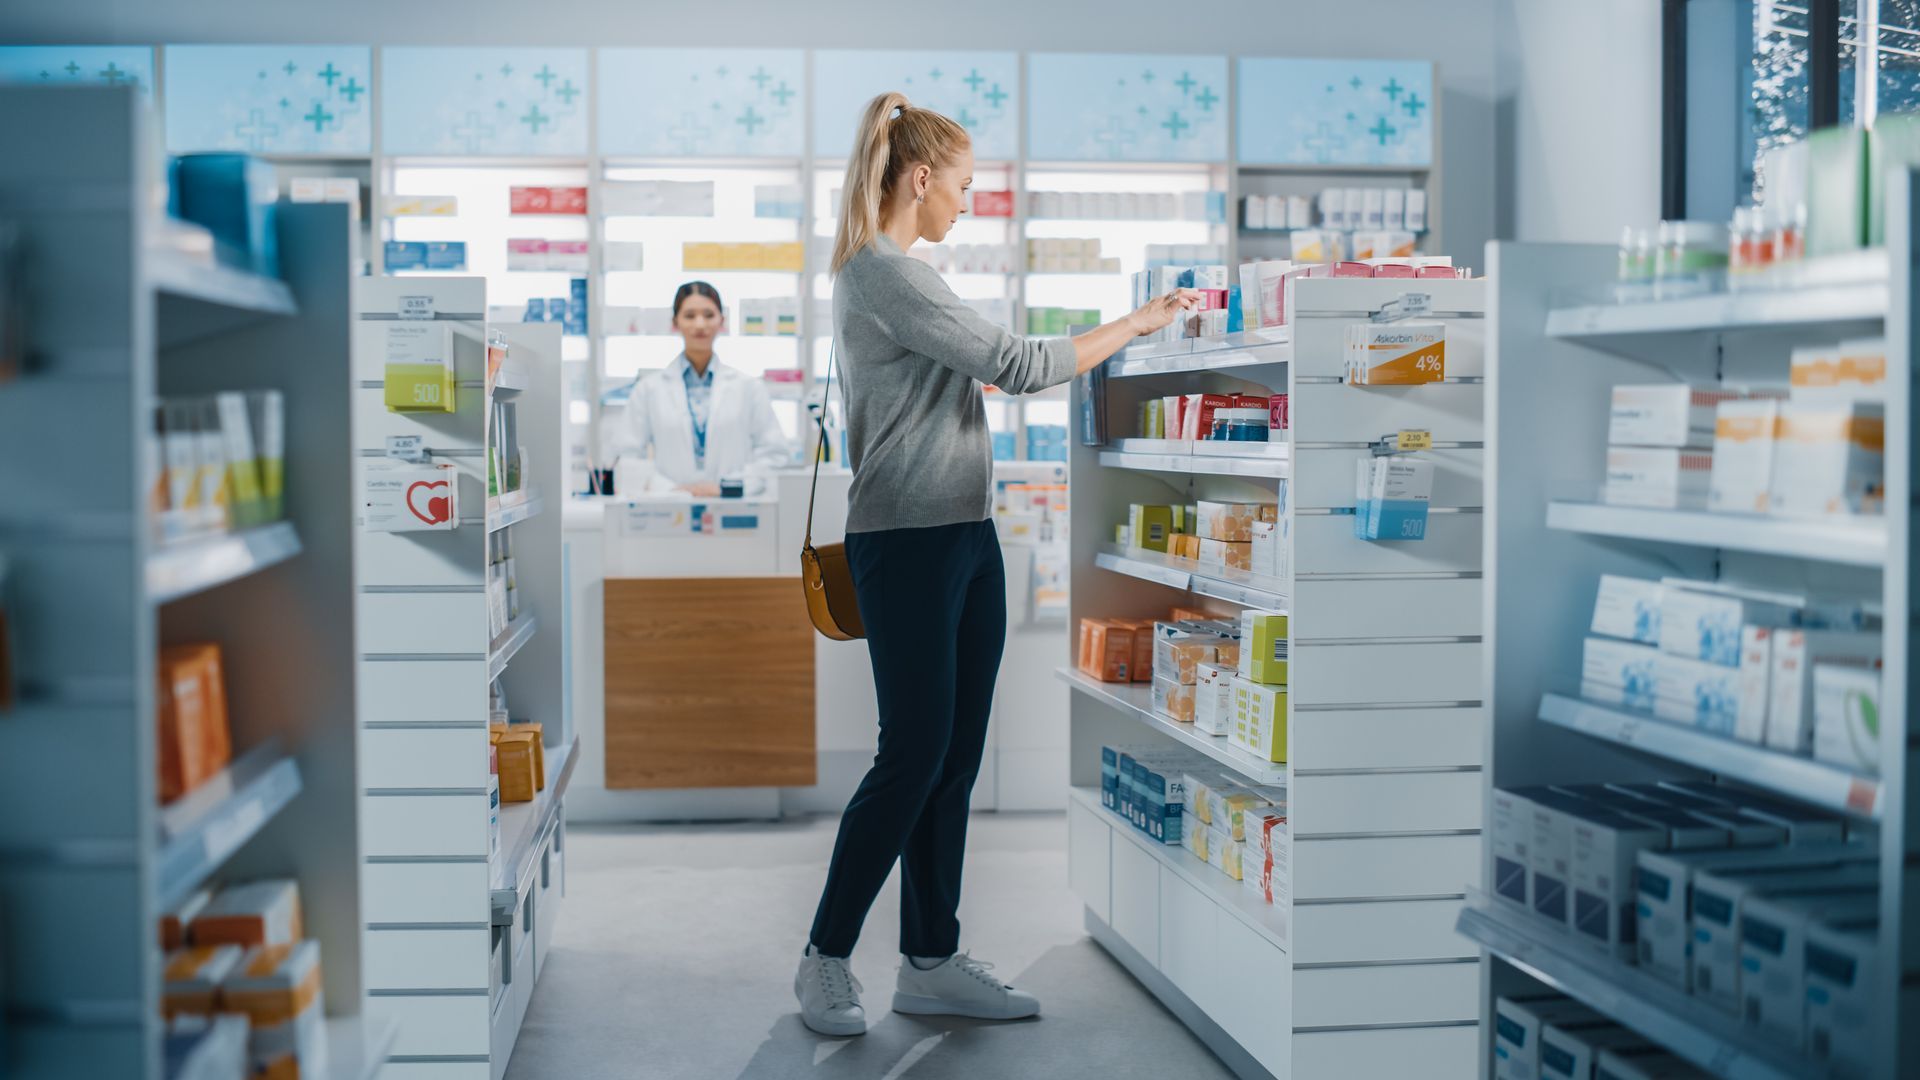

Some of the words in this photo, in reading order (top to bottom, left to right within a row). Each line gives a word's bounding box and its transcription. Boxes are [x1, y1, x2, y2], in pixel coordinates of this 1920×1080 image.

[1374, 334, 1413, 343] Askorbin
[1415, 333, 1434, 342] Vita
[1416, 355, 1441, 371] 4%
[415, 384, 439, 403] 500
[1204, 400, 1226, 408] KARDIO
[1406, 434, 1421, 442] 2.10
[1401, 519, 1422, 536] 500
[1170, 783, 1184, 793] FA
